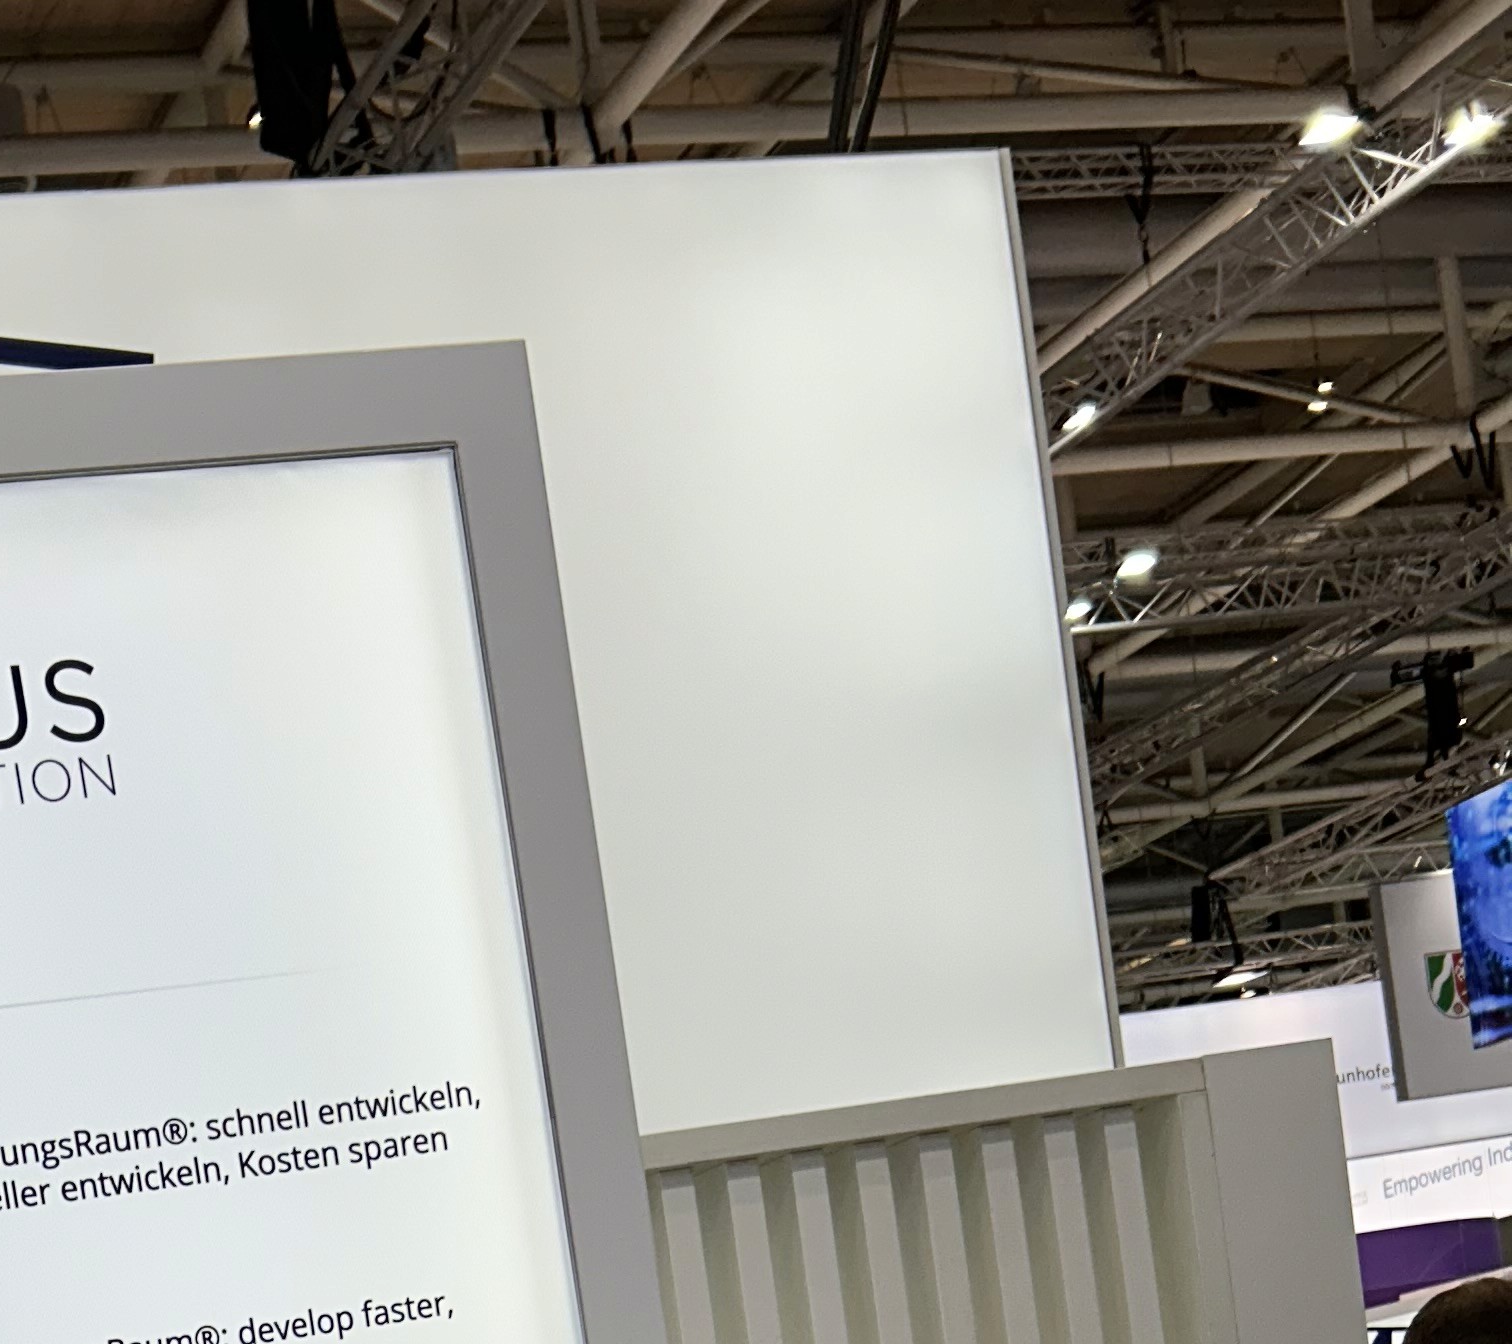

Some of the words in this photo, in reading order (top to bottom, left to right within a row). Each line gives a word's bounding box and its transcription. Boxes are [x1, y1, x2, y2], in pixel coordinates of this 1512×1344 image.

[207, 1100, 308, 1140] schnell
[319, 1082, 479, 1124] entwickeln,
[62, 1157, 228, 1201] entwickeln,
[239, 1147, 339, 1178] Kosten
[349, 1132, 447, 1169] sparen
[1383, 1155, 1483, 1199] Empowering
[239, 1309, 353, 1344] develop
[362, 1296, 452, 1327] faster,
